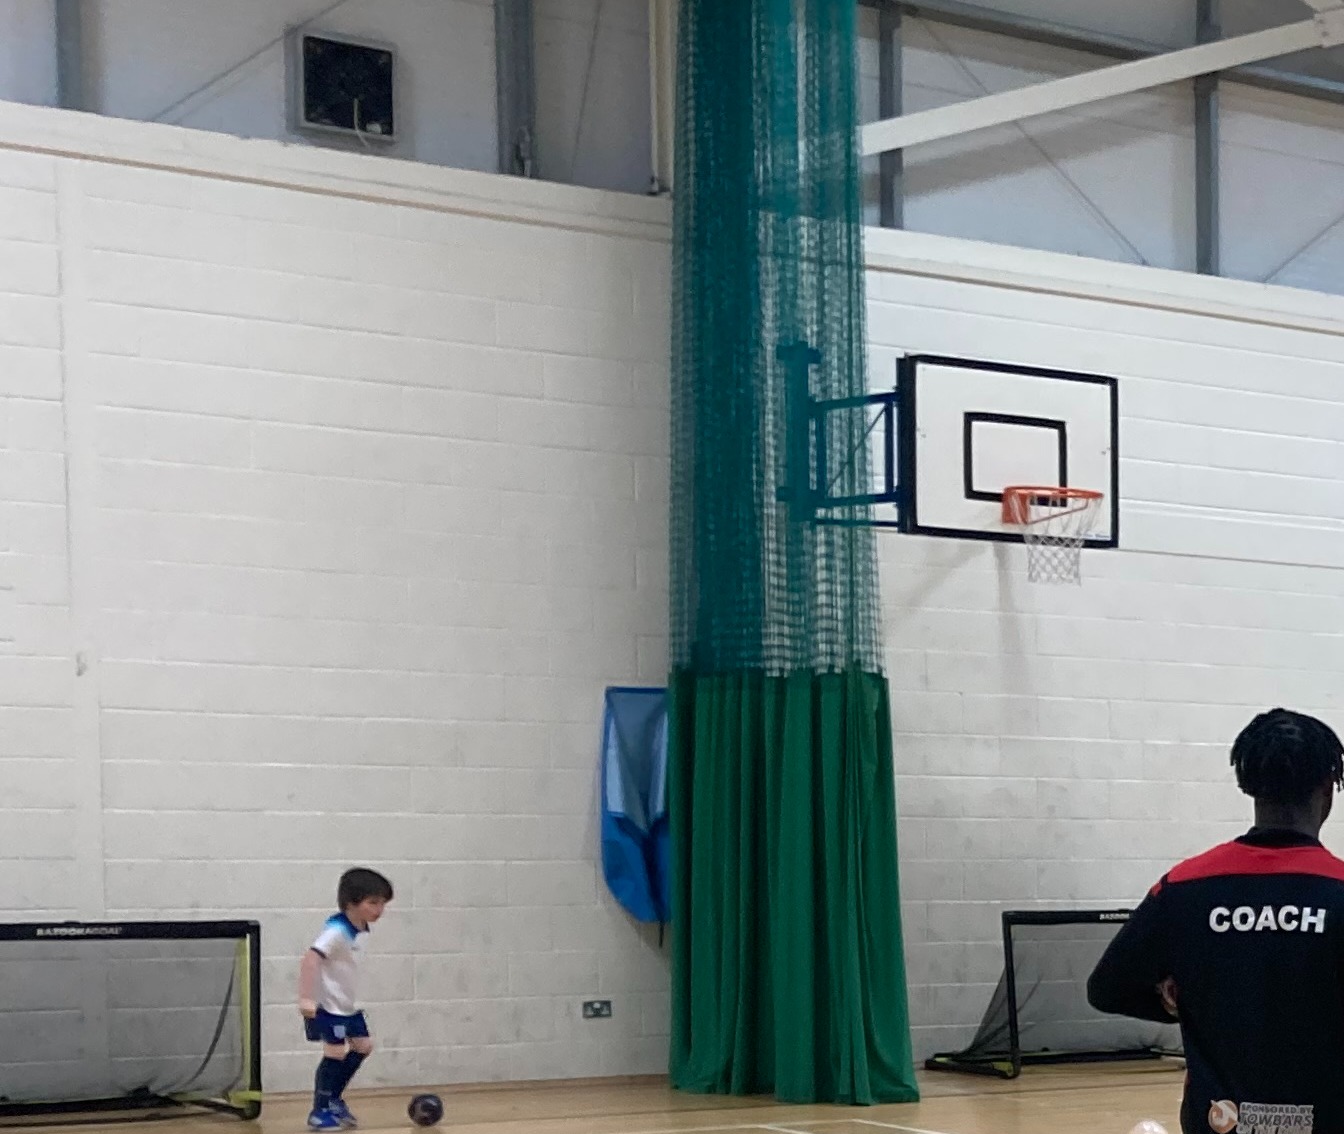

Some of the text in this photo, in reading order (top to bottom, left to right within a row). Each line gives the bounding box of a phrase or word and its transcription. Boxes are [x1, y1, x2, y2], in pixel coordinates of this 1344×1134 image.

[1208, 904, 1327, 933] COACH
[1240, 1103, 1313, 1114] SPONSORED BY
[1239, 1112, 1313, 1127] TOWBARS
